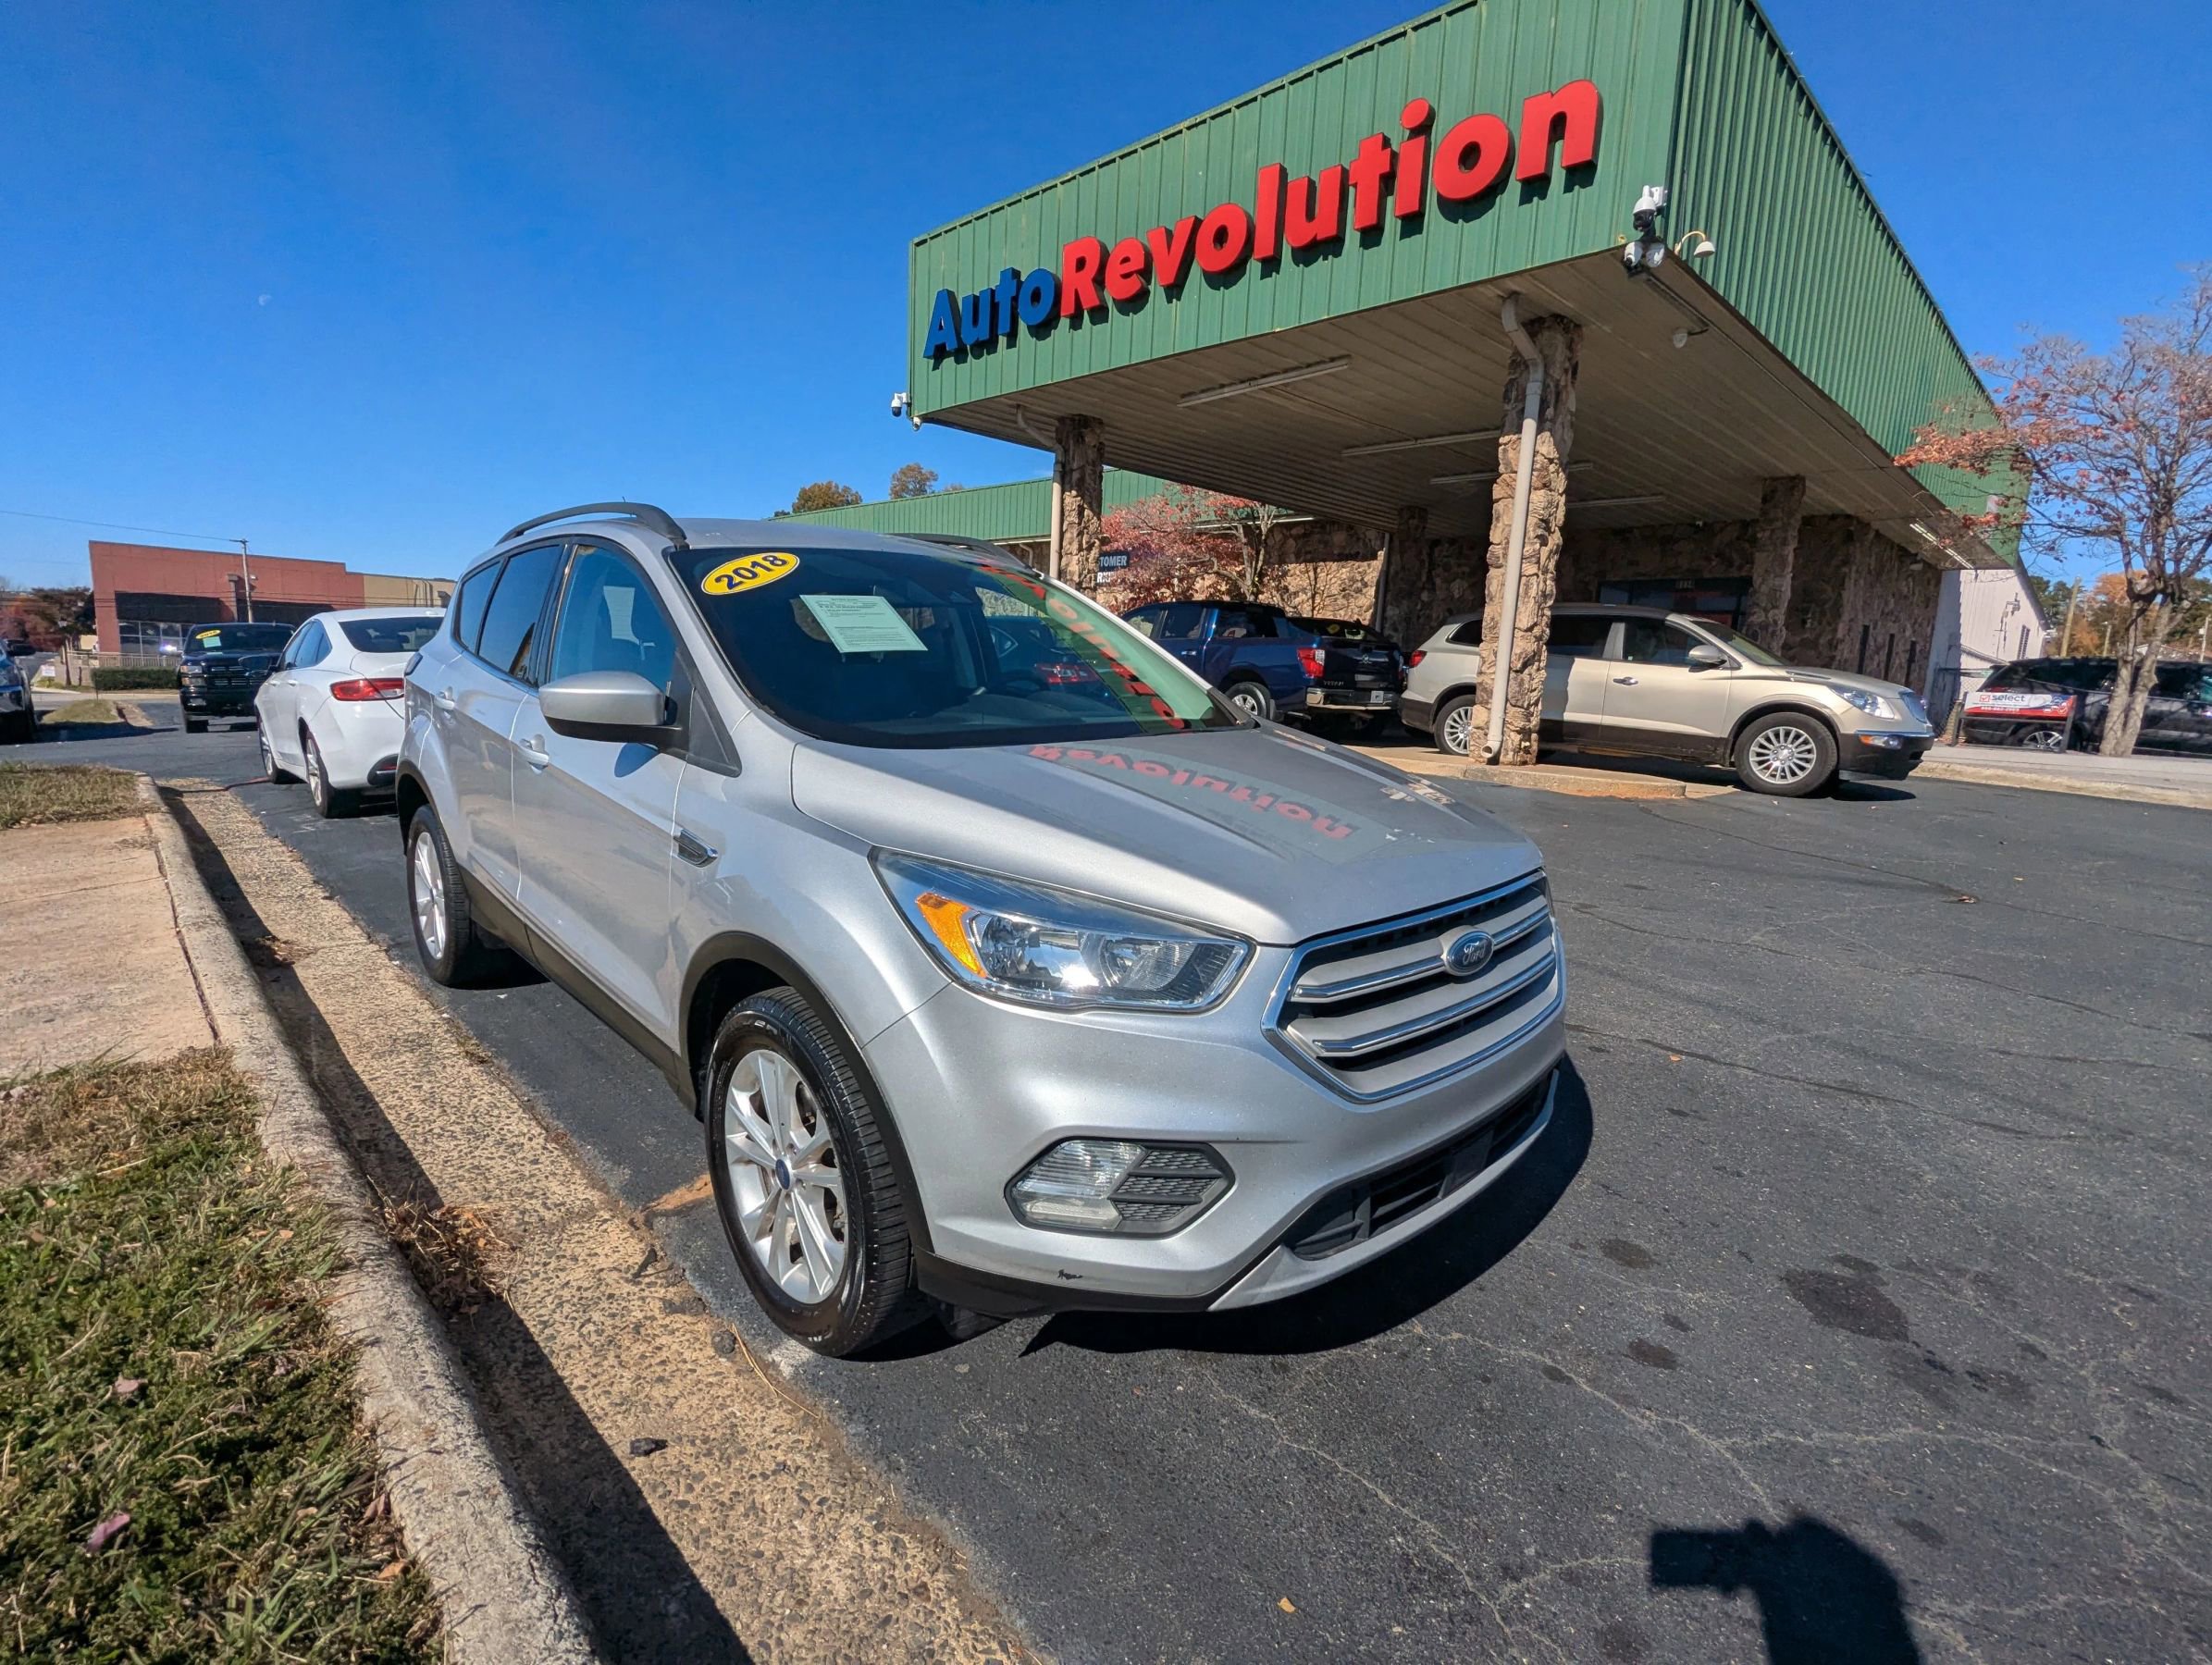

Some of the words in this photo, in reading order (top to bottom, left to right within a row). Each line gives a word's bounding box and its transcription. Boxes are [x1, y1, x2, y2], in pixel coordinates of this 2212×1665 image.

[714, 555, 787, 590] 2018
[1098, 555, 1127, 567] TOMER
[1463, 941, 1486, 965] Ford
